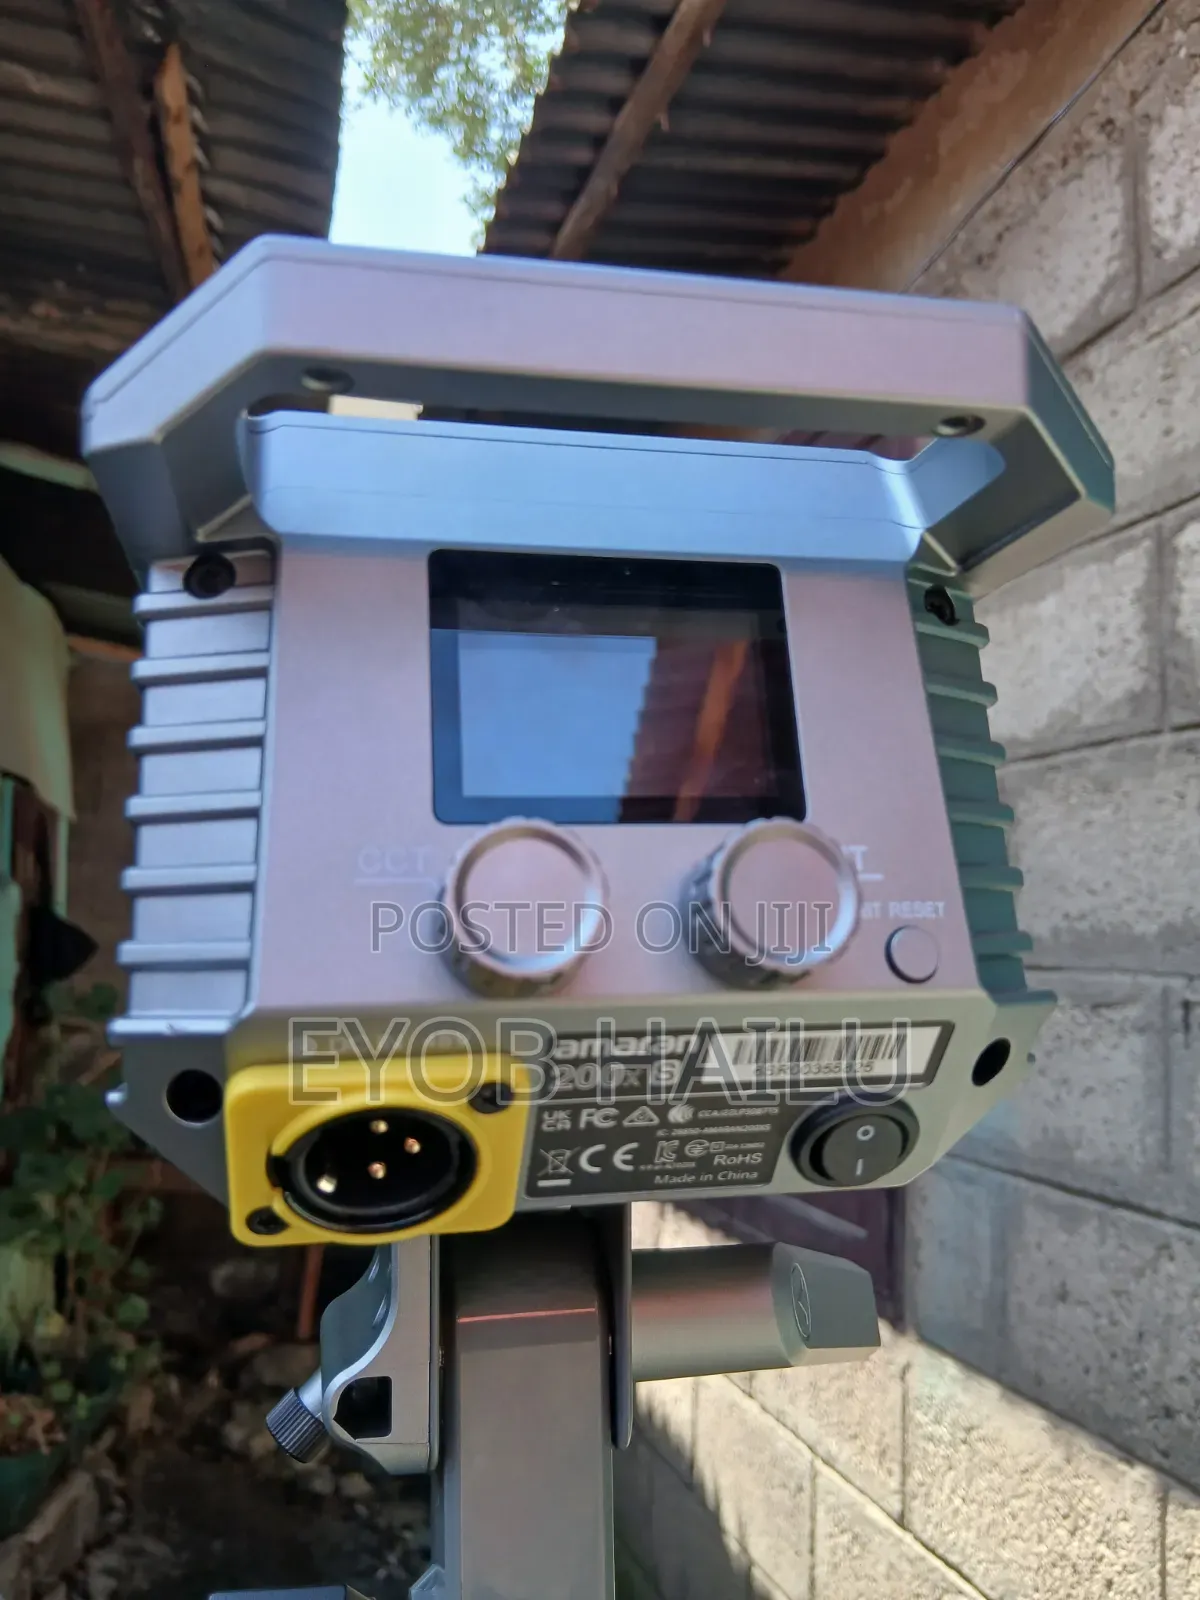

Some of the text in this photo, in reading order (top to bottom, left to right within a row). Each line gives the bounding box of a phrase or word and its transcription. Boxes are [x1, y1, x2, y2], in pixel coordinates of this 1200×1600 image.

[888, 901, 945, 919] RESET
[553, 1033, 701, 1061] amaran
[713, 1152, 763, 1166] RoHS
[654, 1169, 758, 1184] Made in China
